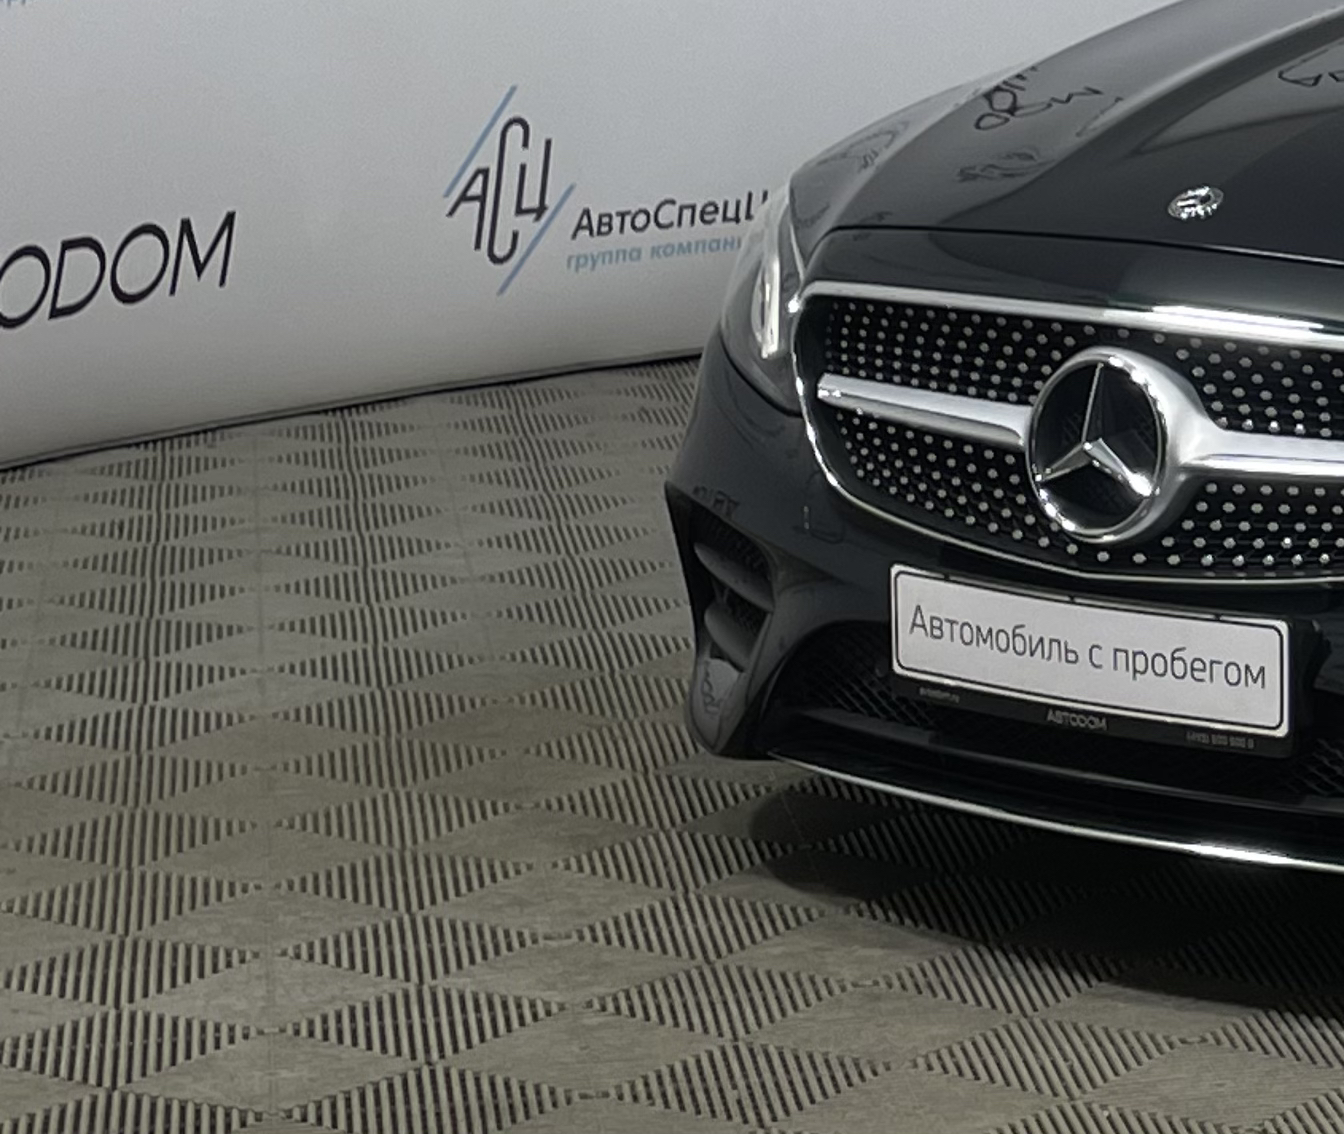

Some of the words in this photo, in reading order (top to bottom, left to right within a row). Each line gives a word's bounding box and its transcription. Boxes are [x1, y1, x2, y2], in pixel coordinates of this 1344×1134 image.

[566, 247, 642, 274] группа
[909, 604, 1079, 665] Автомобиль
[1088, 644, 1104, 670] с
[1112, 646, 1266, 690] пробегом
